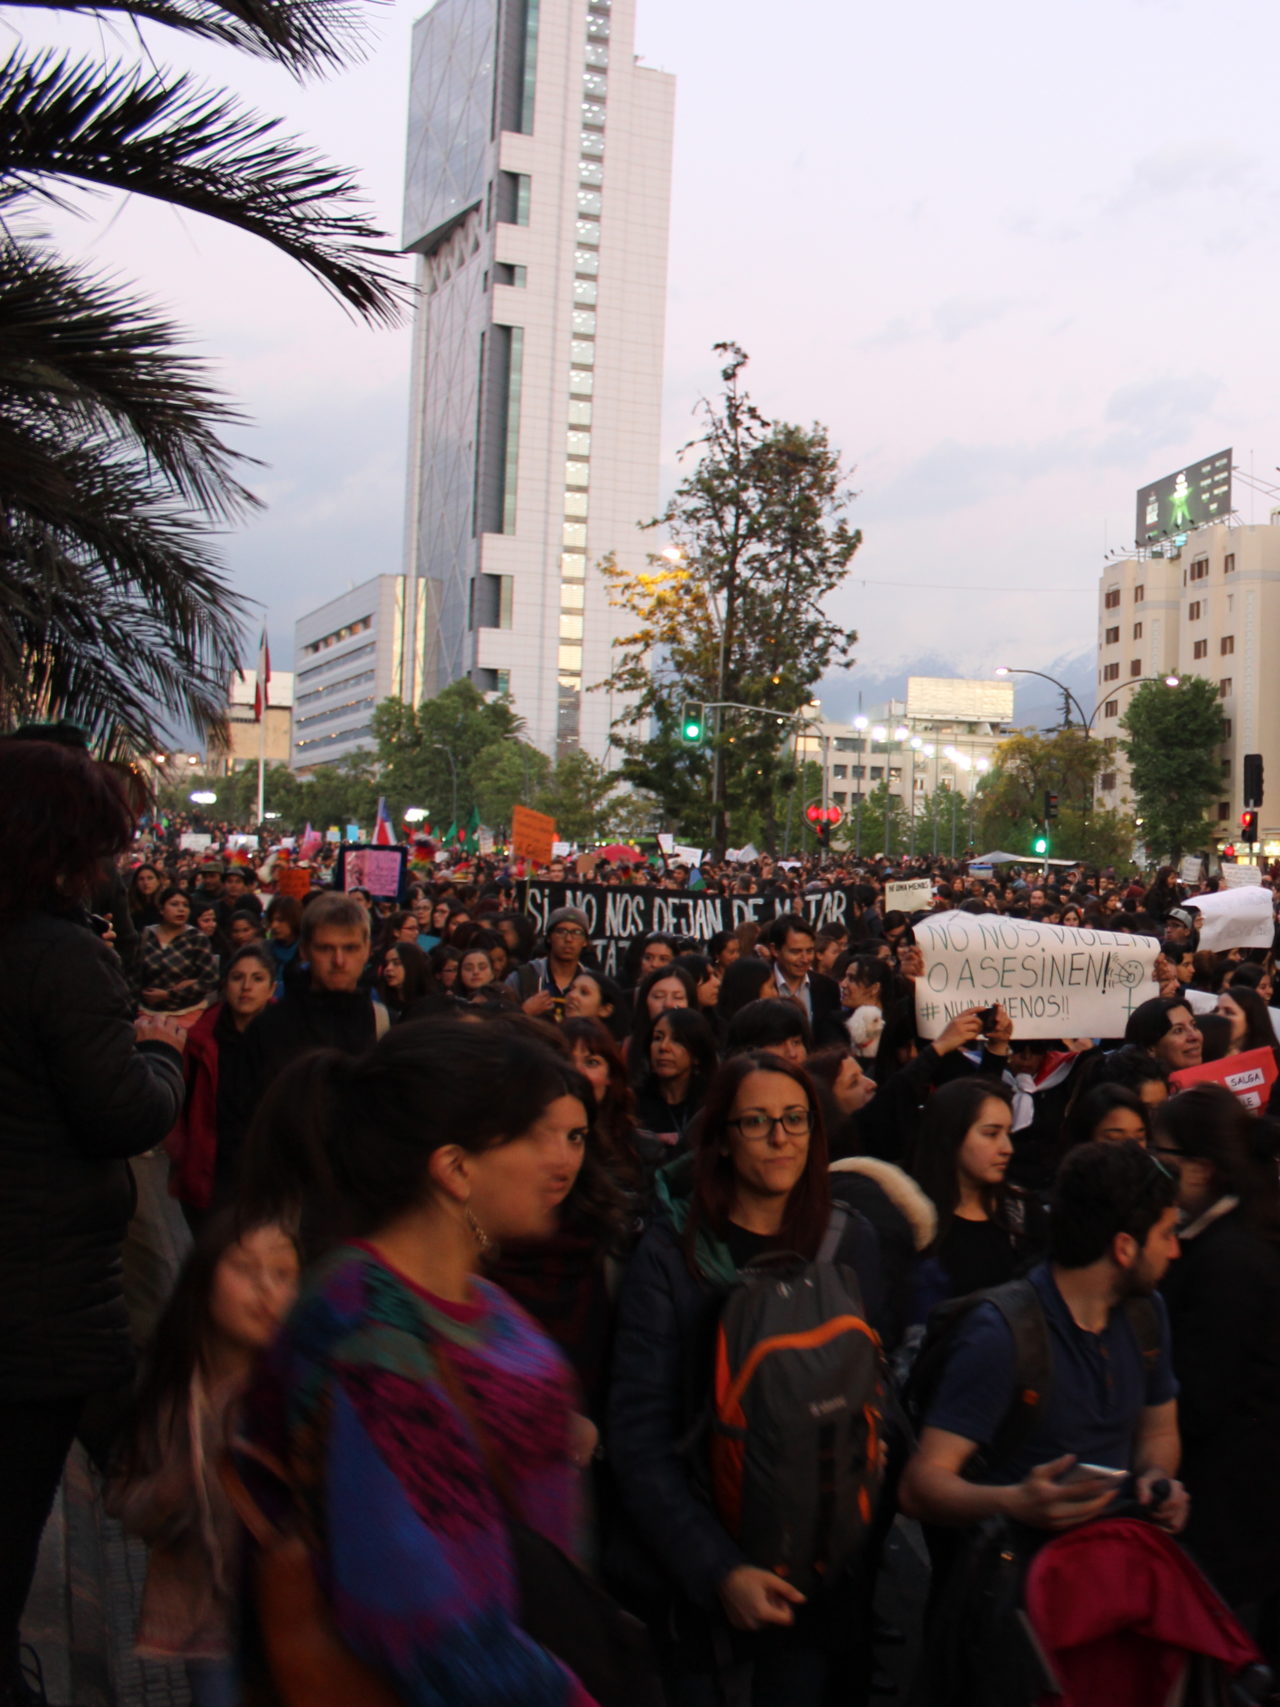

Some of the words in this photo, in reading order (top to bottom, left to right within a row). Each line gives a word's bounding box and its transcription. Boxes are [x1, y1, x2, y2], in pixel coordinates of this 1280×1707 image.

[605, 893, 644, 938] NOS
[652, 897, 723, 940] DEJAN
[774, 890, 849, 934] MTAR
[928, 920, 970, 951] NO
[980, 919, 1041, 951] NOS
[927, 962, 949, 992] O
[1230, 1073, 1261, 1087] SALGA
